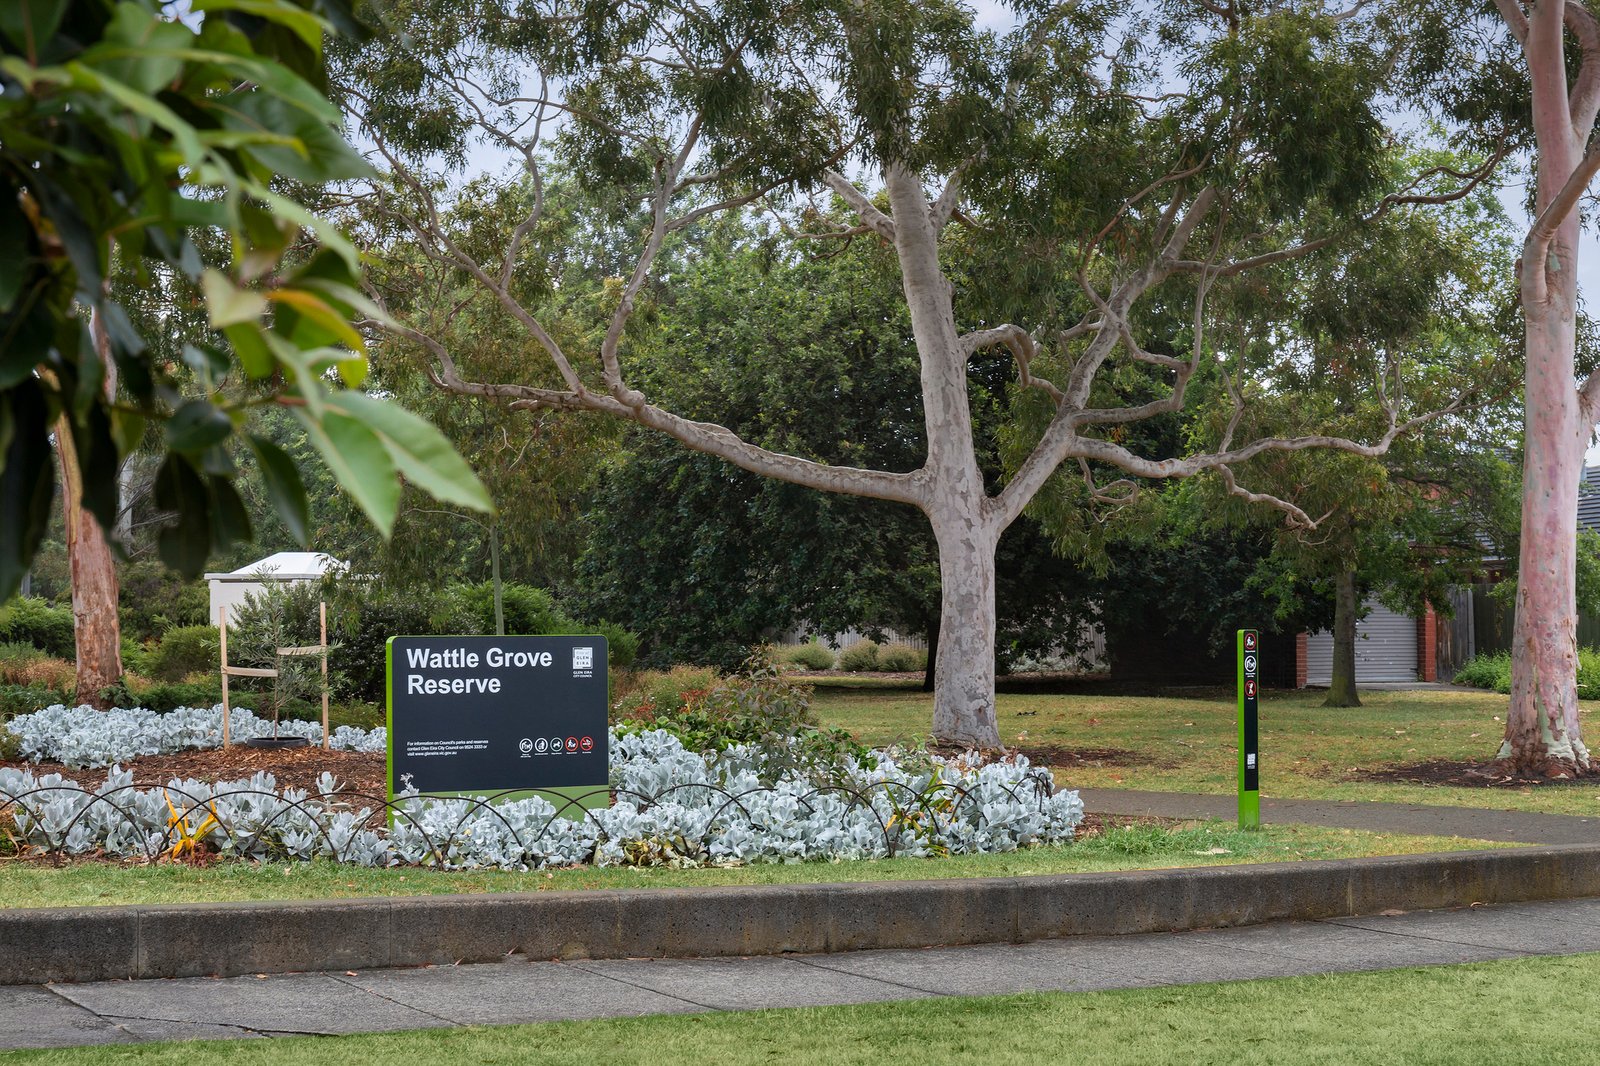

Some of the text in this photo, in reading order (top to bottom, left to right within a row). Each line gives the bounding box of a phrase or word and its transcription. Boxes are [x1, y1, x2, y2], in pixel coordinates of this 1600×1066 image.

[406, 647, 553, 669] Wattle Grove
[407, 674, 501, 695] Reserve
